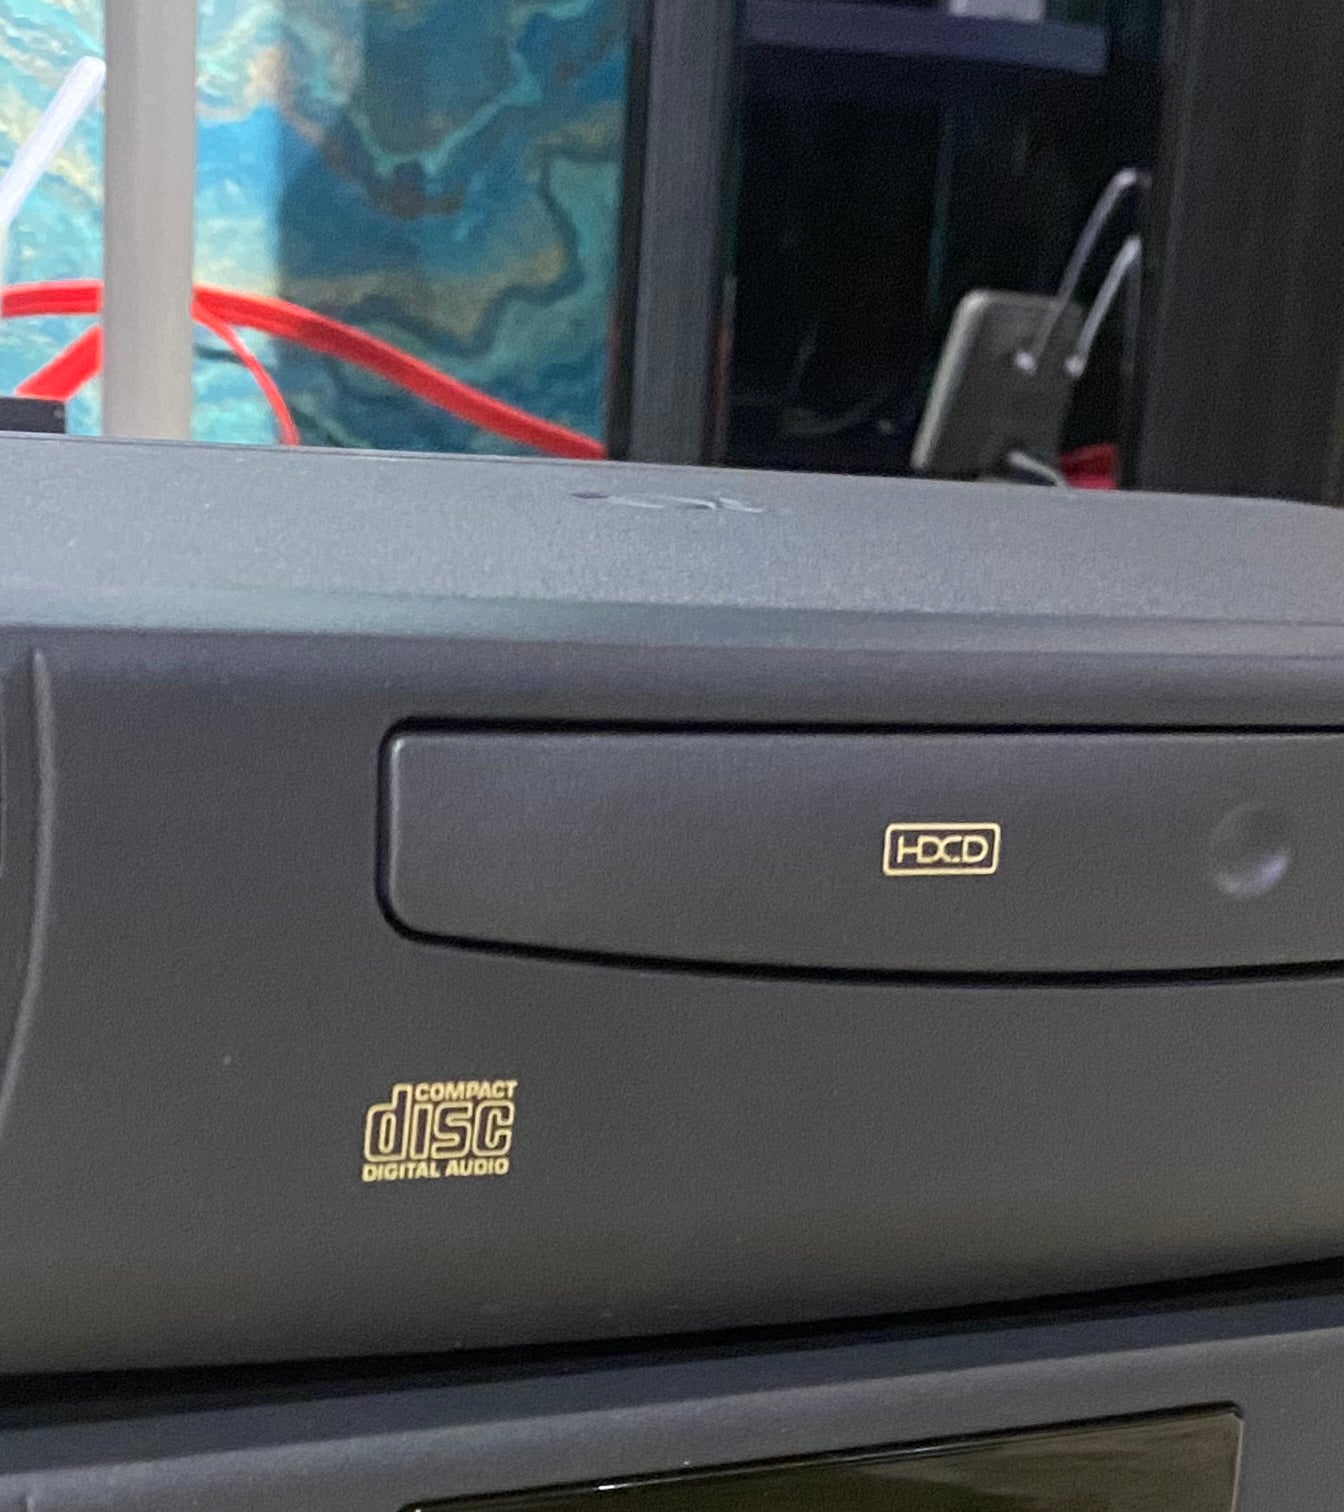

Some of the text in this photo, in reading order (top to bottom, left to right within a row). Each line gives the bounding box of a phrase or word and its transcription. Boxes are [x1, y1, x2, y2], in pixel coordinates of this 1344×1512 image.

[896, 835, 989, 864] HDCD
[415, 1080, 519, 1102] COMPACT
[362, 1157, 510, 1183] DIGITAL AUDIO
